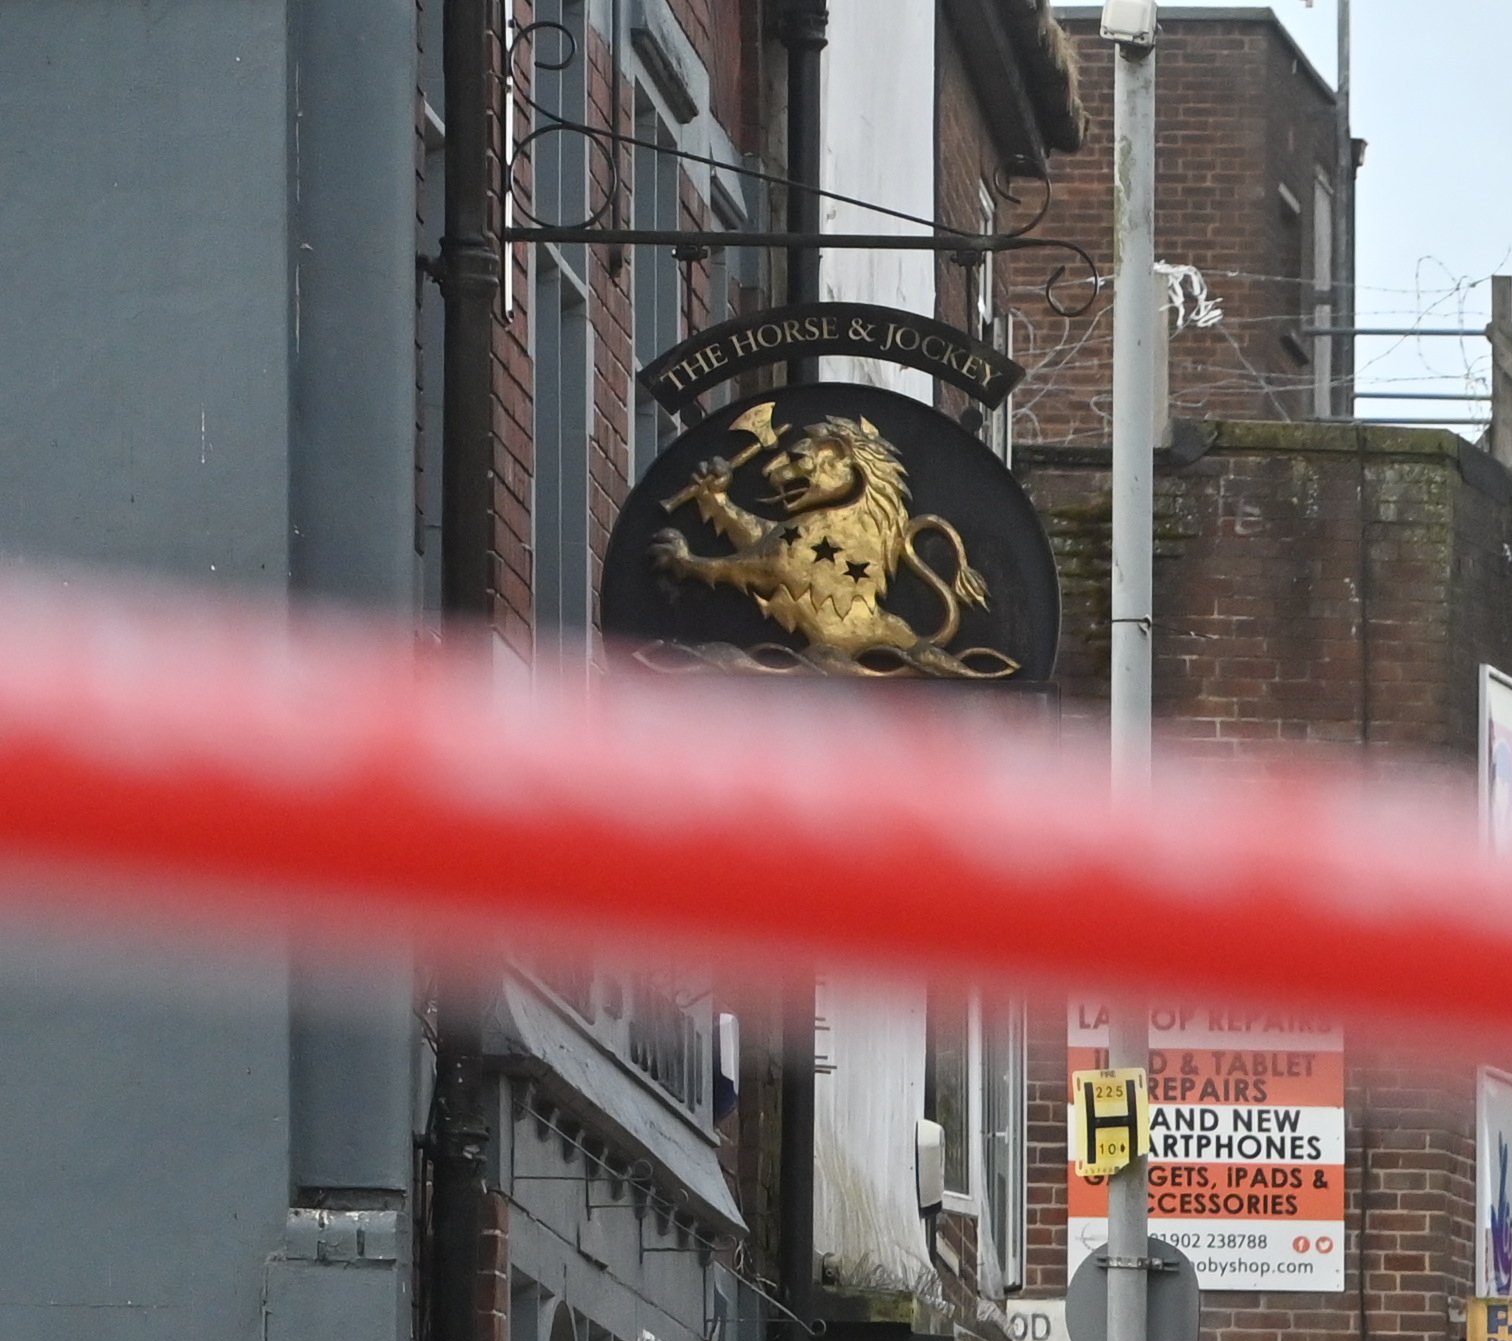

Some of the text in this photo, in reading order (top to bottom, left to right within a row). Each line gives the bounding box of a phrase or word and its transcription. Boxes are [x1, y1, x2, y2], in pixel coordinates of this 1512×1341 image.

[659, 317, 1002, 392] THE HORSE & JOCKEY
[1181, 1052, 1199, 1076] &
[1211, 1051, 1316, 1078] TABLET
[1096, 1085, 1124, 1099] 225
[1149, 1108, 1301, 1133] AND NEW
[1227, 1166, 1303, 1189] iPADS
[1312, 1168, 1328, 1189] &
[1148, 1193, 1299, 1215] CCESSORIES
[1207, 1233, 1268, 1249] 238788
[1190, 1257, 1314, 1278] obyshop.com
